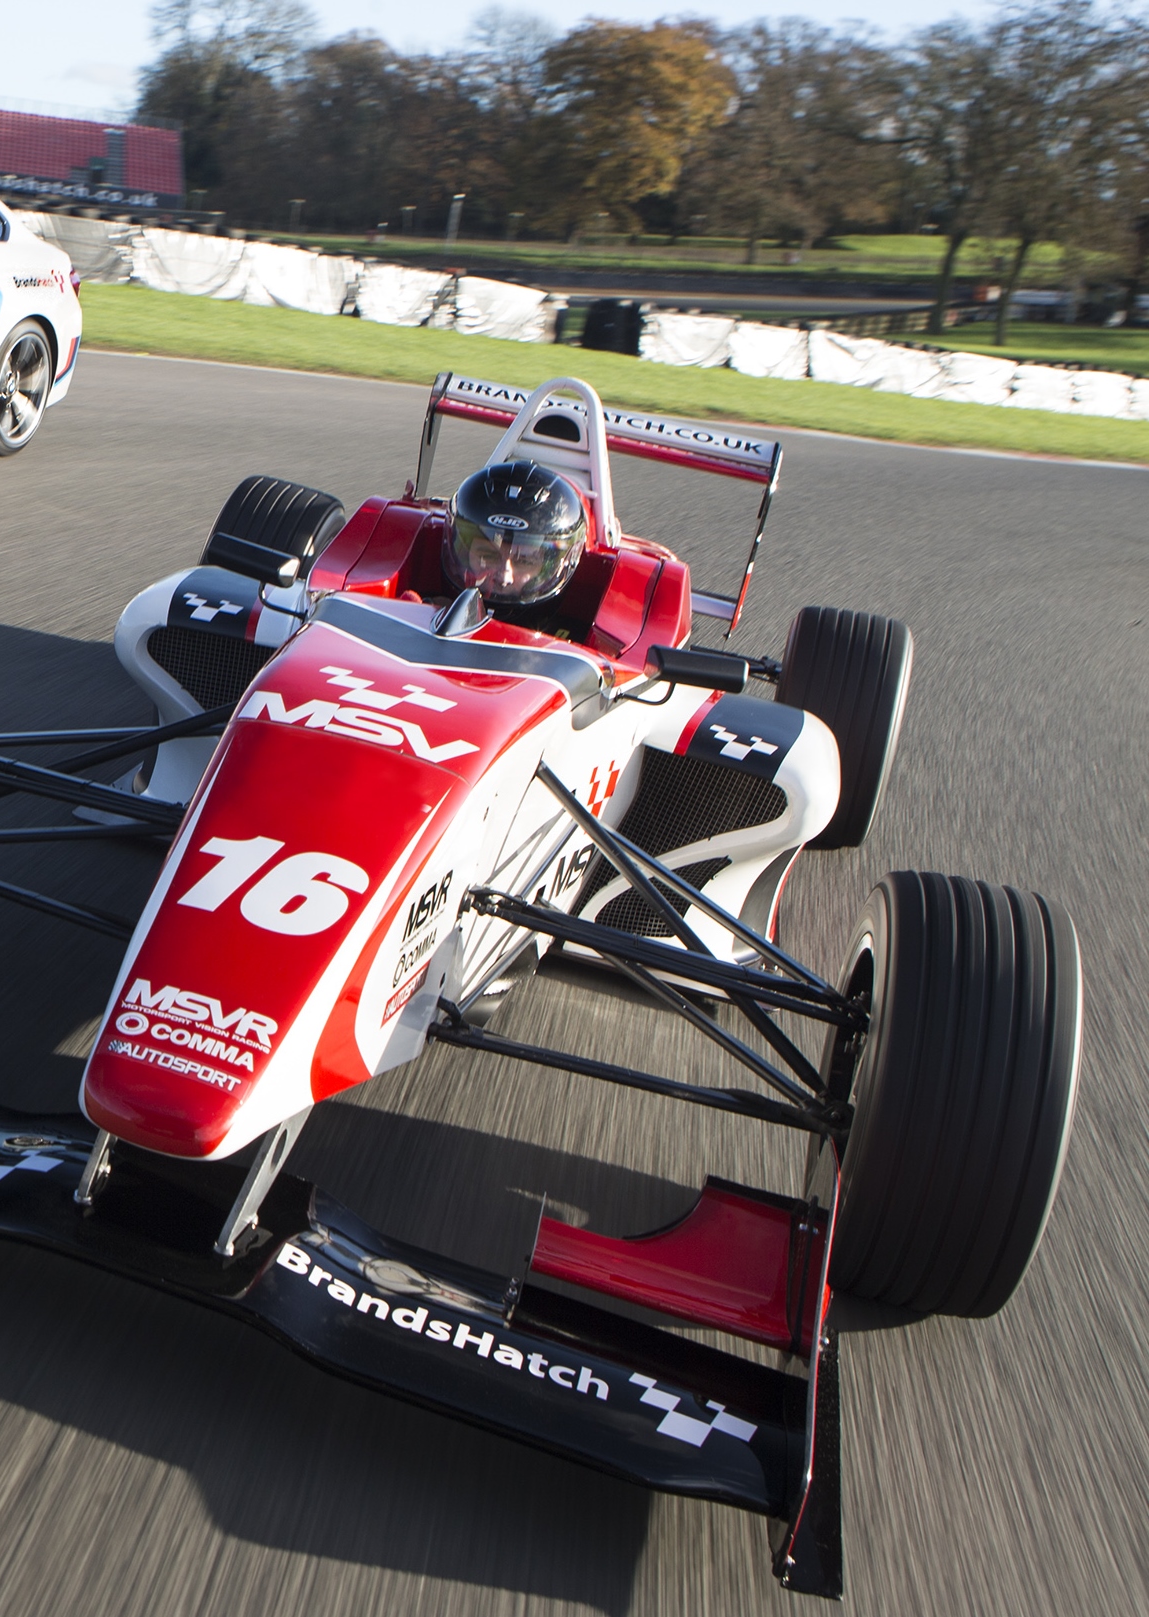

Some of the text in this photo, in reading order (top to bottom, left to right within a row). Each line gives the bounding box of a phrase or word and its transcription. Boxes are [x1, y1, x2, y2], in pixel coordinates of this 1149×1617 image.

[237, 691, 480, 764] MSV
[177, 836, 370, 936] 16
[402, 869, 454, 942] MSVR
[121, 1000, 271, 1055] MOTORSPORT VISION RACING
[124, 978, 279, 1049] MSVR
[150, 1023, 254, 1073] COMMA
[118, 1042, 242, 1092] AUTOSPORT
[275, 1242, 610, 1401] BrandsHatch
